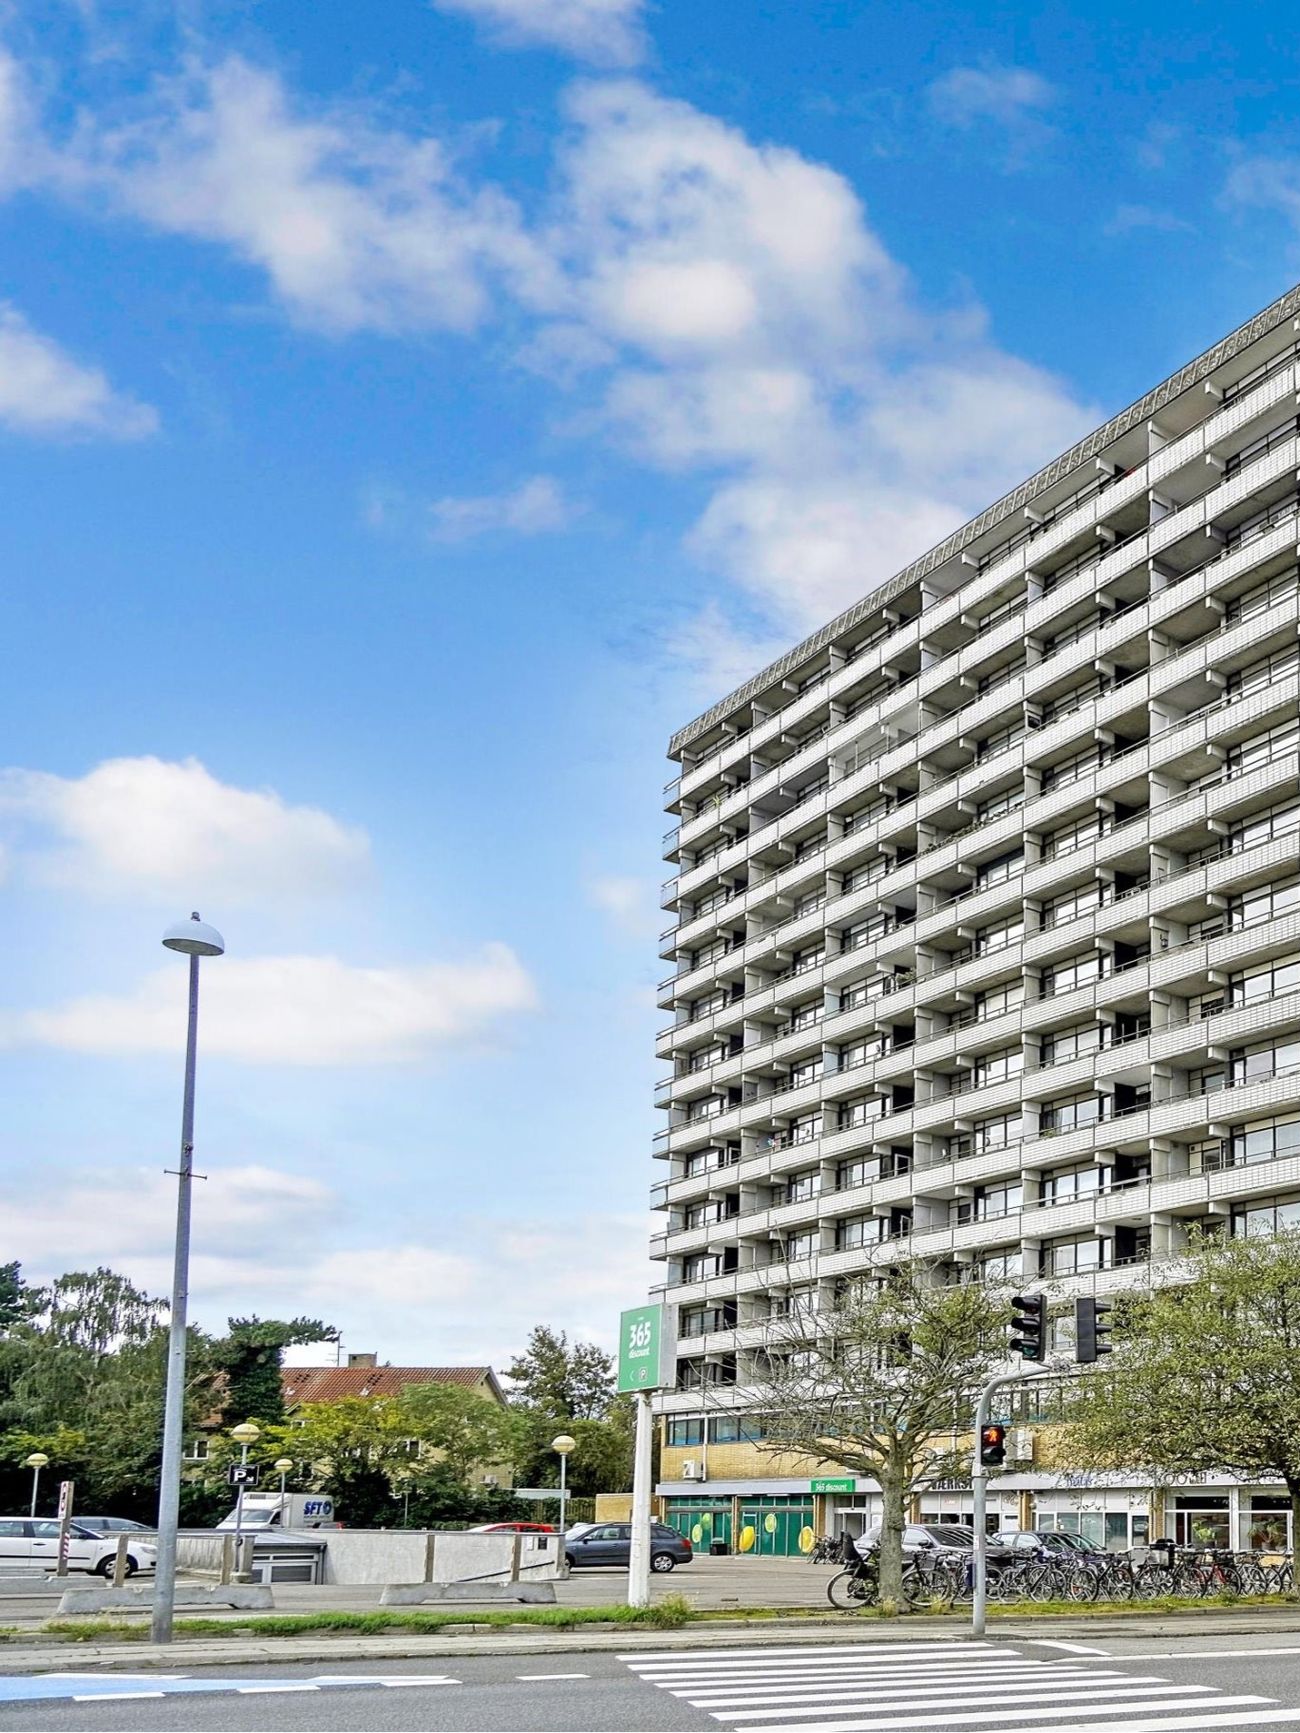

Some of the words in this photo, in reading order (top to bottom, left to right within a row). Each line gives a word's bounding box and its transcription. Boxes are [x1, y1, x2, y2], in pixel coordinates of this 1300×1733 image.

[629, 1321, 651, 1348] 365
[234, 1471, 246, 1482] P
[304, 1501, 323, 1515] SFT
